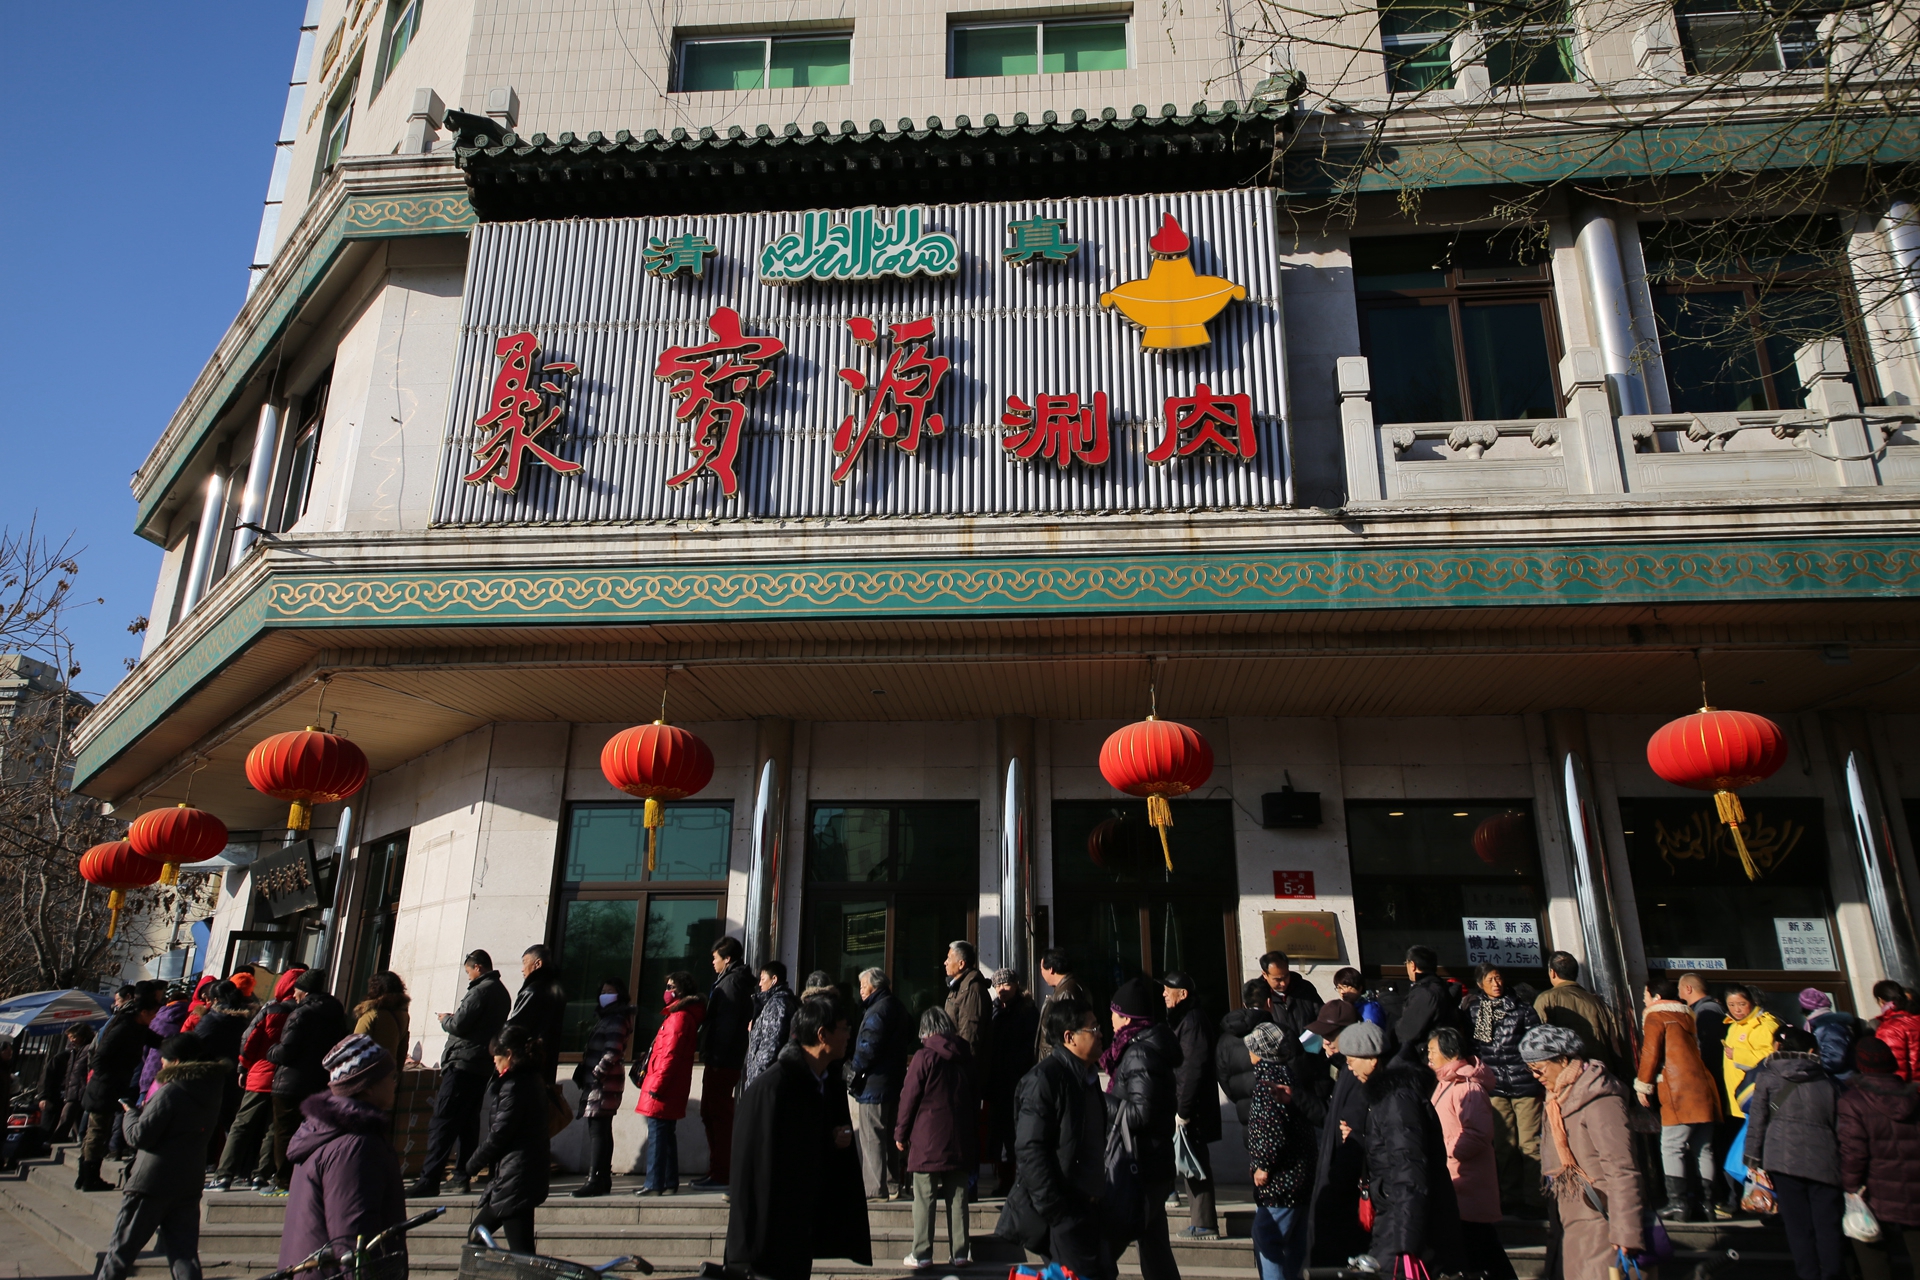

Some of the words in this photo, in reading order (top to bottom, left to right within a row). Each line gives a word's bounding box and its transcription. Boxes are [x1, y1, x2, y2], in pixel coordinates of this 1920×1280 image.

[642, 233, 718, 277] 清
[1002, 215, 1079, 265] 真
[1001, 383, 1257, 467] 涮肉
[1283, 882, 1305, 895] 5-2
[1467, 919, 1496, 931] 新添
[1504, 922, 1533, 933] 新添
[1788, 921, 1815, 932] 新添
[1470, 952, 1502, 964] 6元/个
[1506, 952, 1540, 964] 2.5元/个
[1650, 959, 1724, 969] 入口食品概不退换
